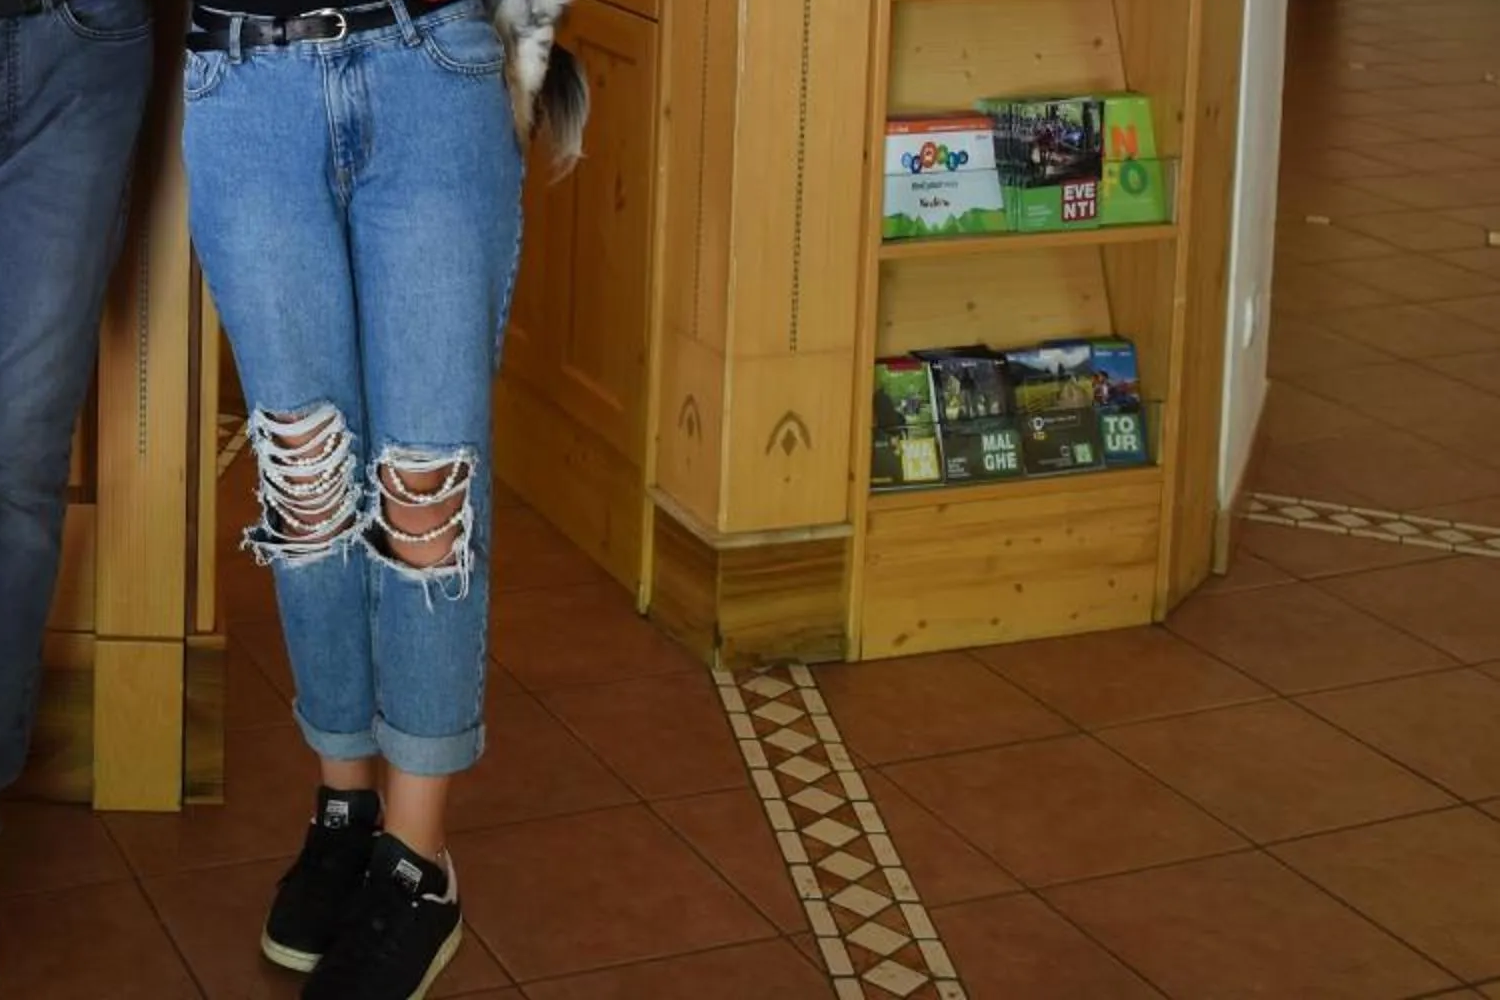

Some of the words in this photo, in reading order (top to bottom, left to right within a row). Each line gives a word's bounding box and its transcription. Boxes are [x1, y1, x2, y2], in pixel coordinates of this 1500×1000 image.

[1063, 181, 1095, 201] EVE
[1063, 199, 1095, 219] NTI
[1103, 415, 1135, 435] TO
[981, 432, 1015, 452] MAL
[1107, 433, 1138, 452] UR
[984, 451, 1018, 471] GHE
